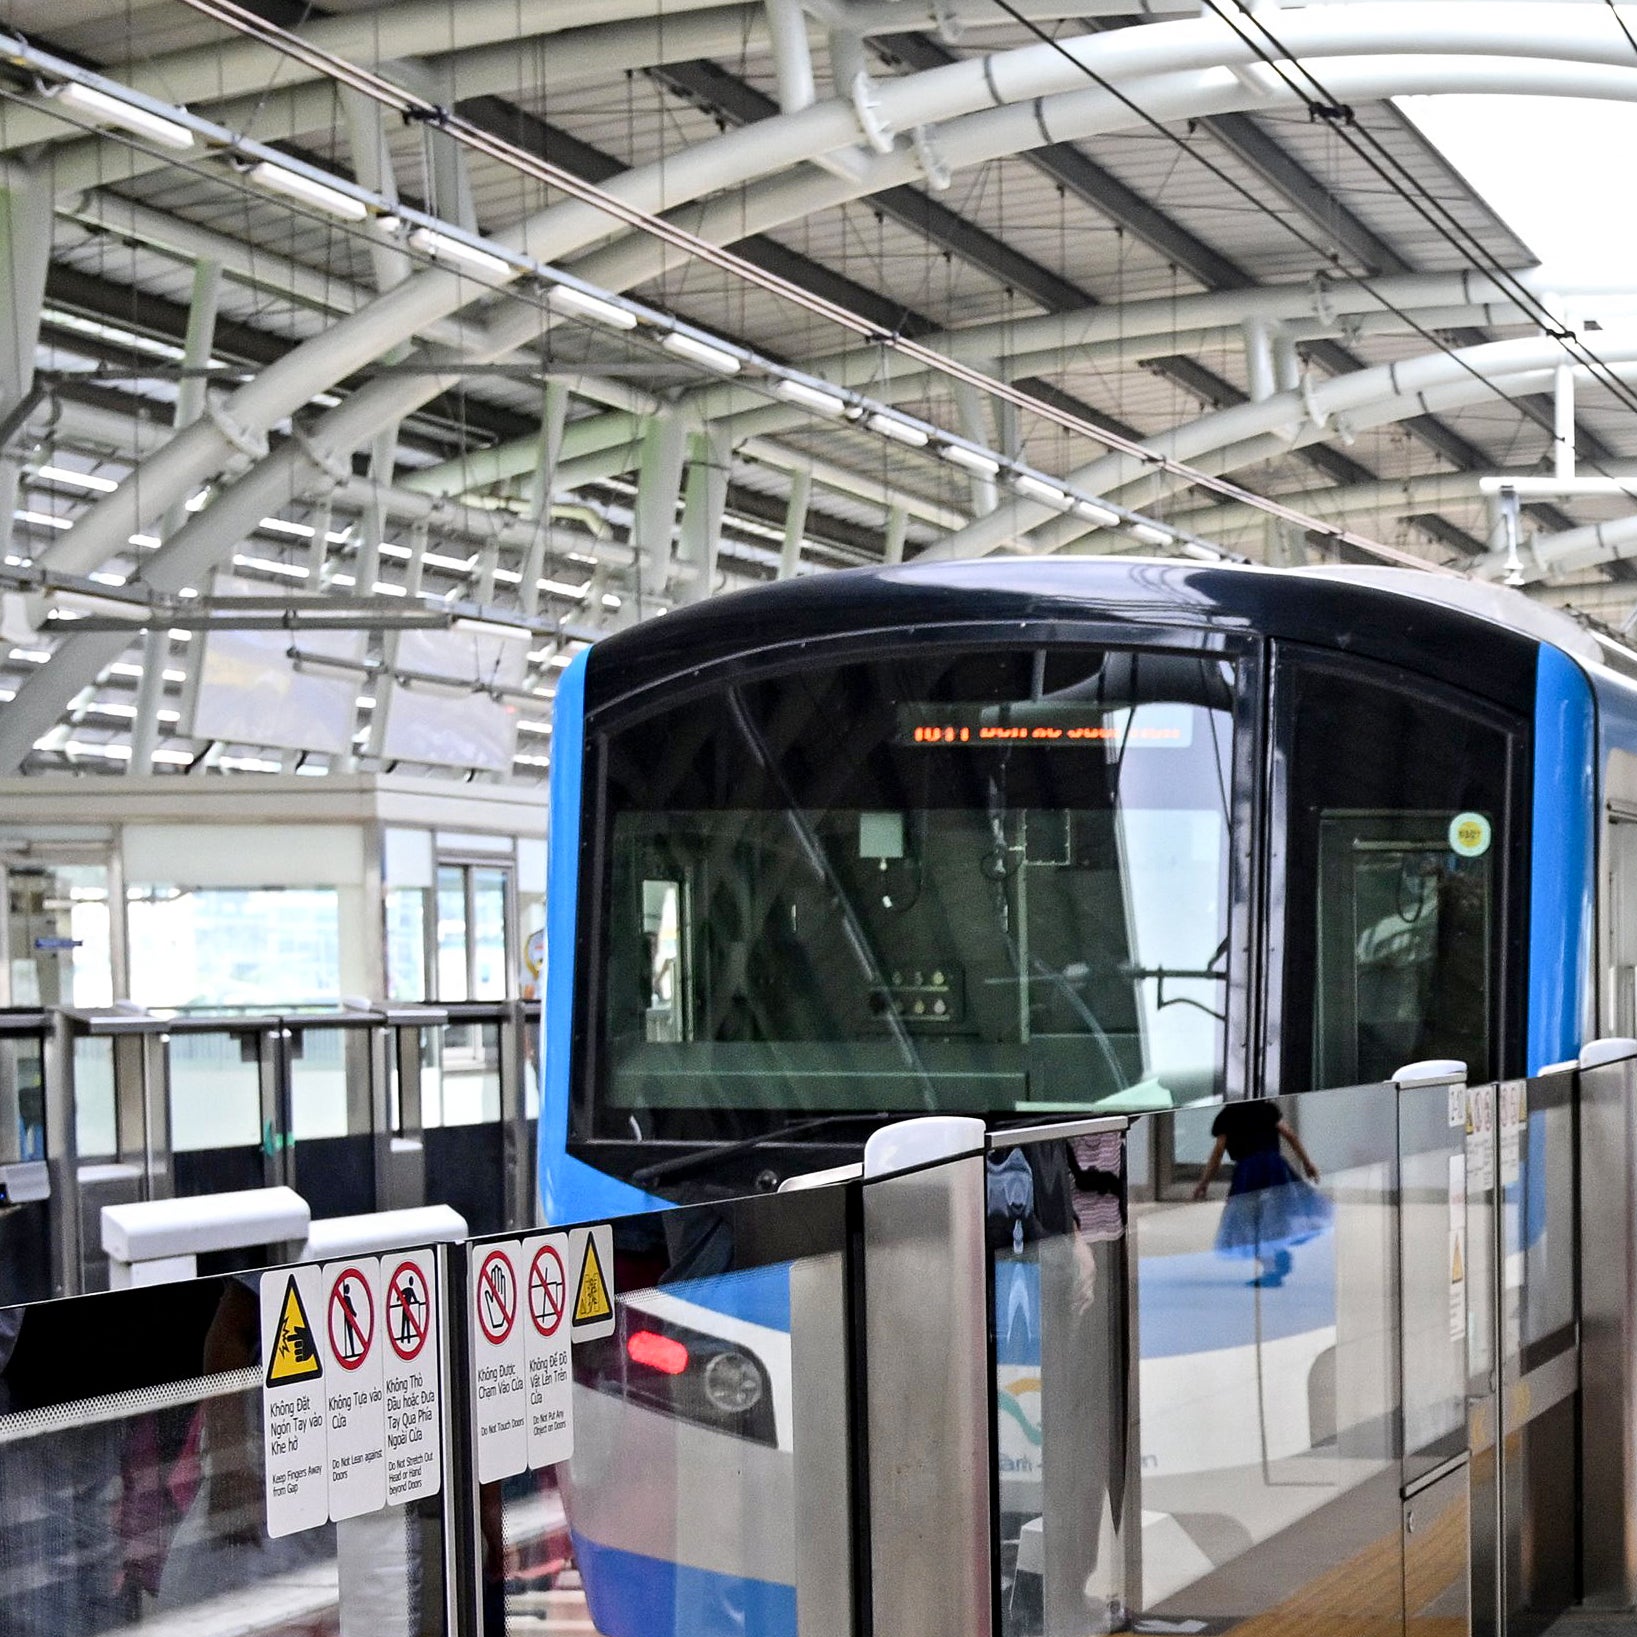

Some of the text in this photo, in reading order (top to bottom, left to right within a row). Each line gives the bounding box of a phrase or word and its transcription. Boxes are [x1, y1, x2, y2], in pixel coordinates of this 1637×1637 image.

[530, 1357, 548, 1372] Không
[478, 1366, 498, 1382] Không
[542, 1372, 552, 1385] Lên
[554, 1368, 567, 1382] Trên
[386, 1373, 423, 1395] Không Thò
[498, 1380, 510, 1394] Vào
[512, 1376, 524, 1391] Cửa
[270, 1394, 310, 1417] Không Đặt
[329, 1386, 382, 1412] Không Tựa vào
[403, 1393, 419, 1410] hoặc
[421, 1390, 435, 1404] Đưa
[530, 1390, 542, 1405] Cửa
[271, 1412, 323, 1439] Ngón Tay vào
[332, 1412, 346, 1429] Cửa
[388, 1408, 432, 1431] Tay Qua Phía
[272, 1435, 298, 1456] Khe hở
[388, 1428, 423, 1449] Ngoài Cửa
[332, 1459, 340, 1469] Do
[341, 1455, 350, 1467] Not
[351, 1453, 363, 1465] Lean
[388, 1452, 433, 1471] Do Not Stretch Out
[273, 1465, 322, 1485] Keep Fingers Away
[333, 1470, 348, 1482] Doors
[389, 1466, 422, 1483] Head or Hand
[273, 1483, 298, 1497] from Gap
[389, 1479, 422, 1496] beyond Doors
